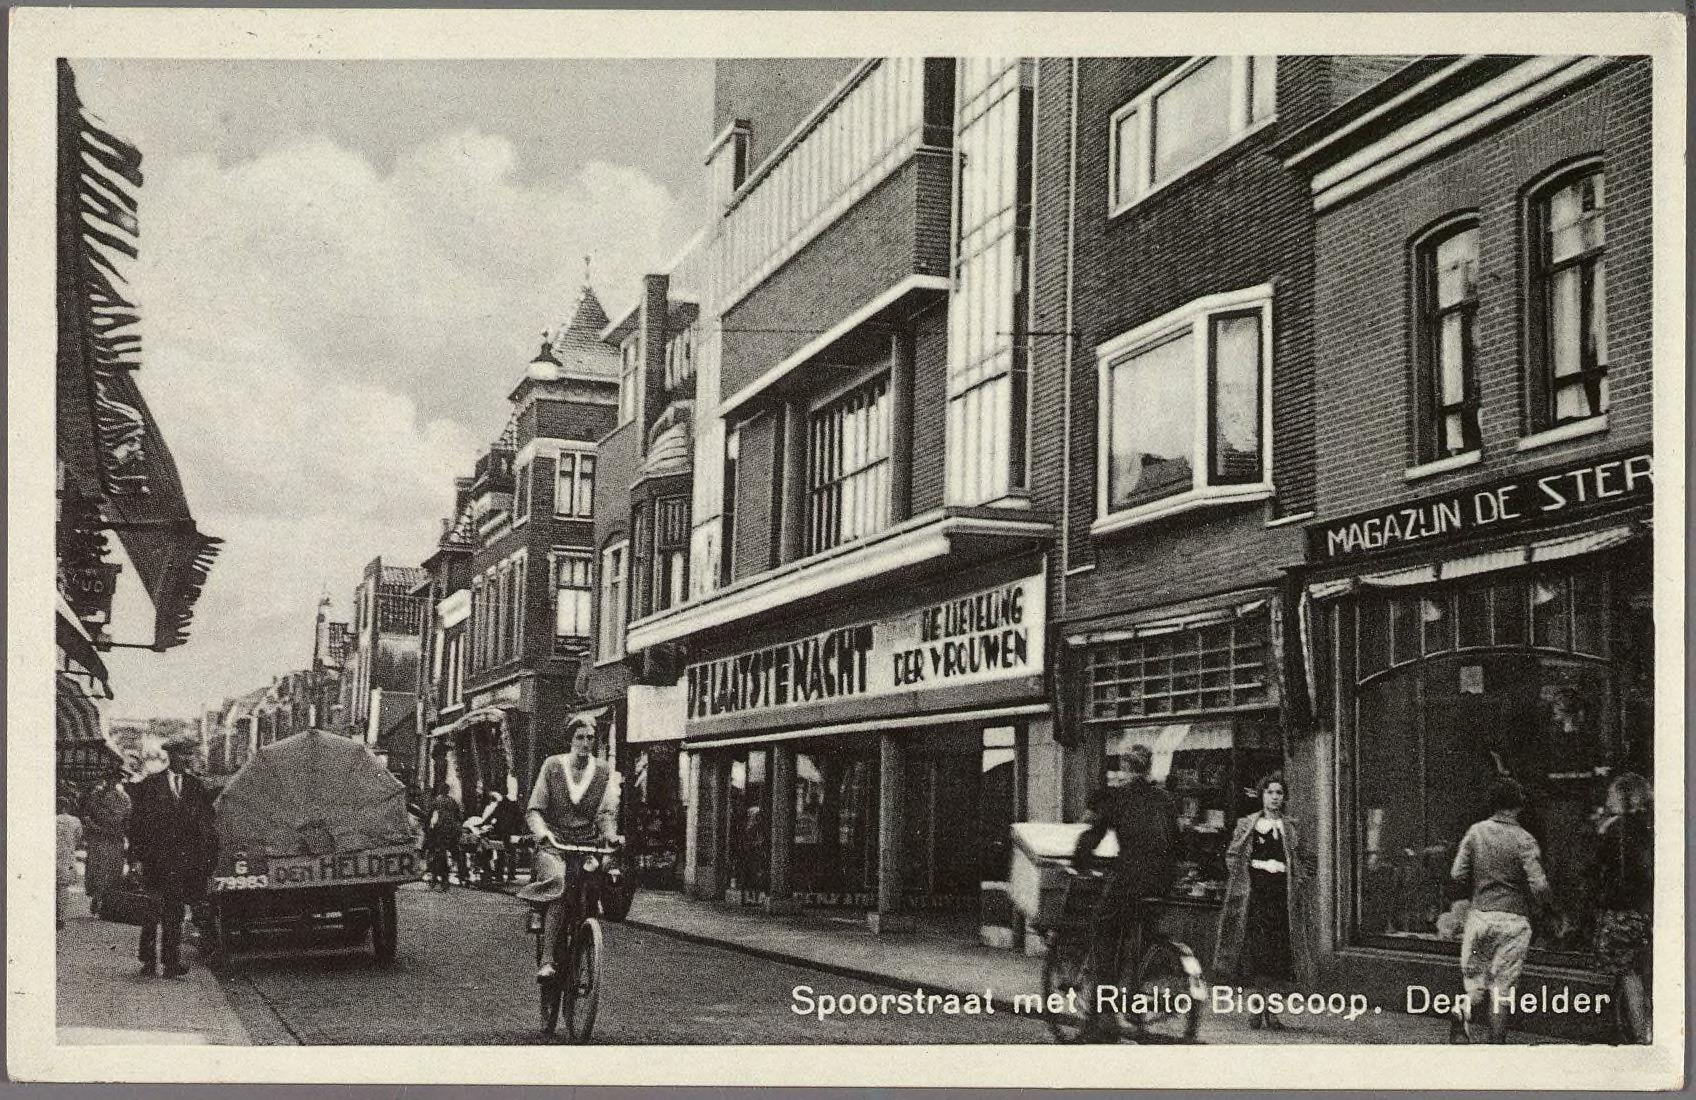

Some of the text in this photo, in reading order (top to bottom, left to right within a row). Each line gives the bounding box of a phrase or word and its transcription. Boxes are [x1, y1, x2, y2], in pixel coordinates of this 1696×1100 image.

[1327, 454, 1654, 556] MAGAZIJN DE STER
[921, 606, 943, 642] DE
[687, 625, 874, 719] DE LAATSTE NACHT
[893, 628, 1028, 687] DER VROUWEN
[275, 852, 415, 884] DEN HELDER
